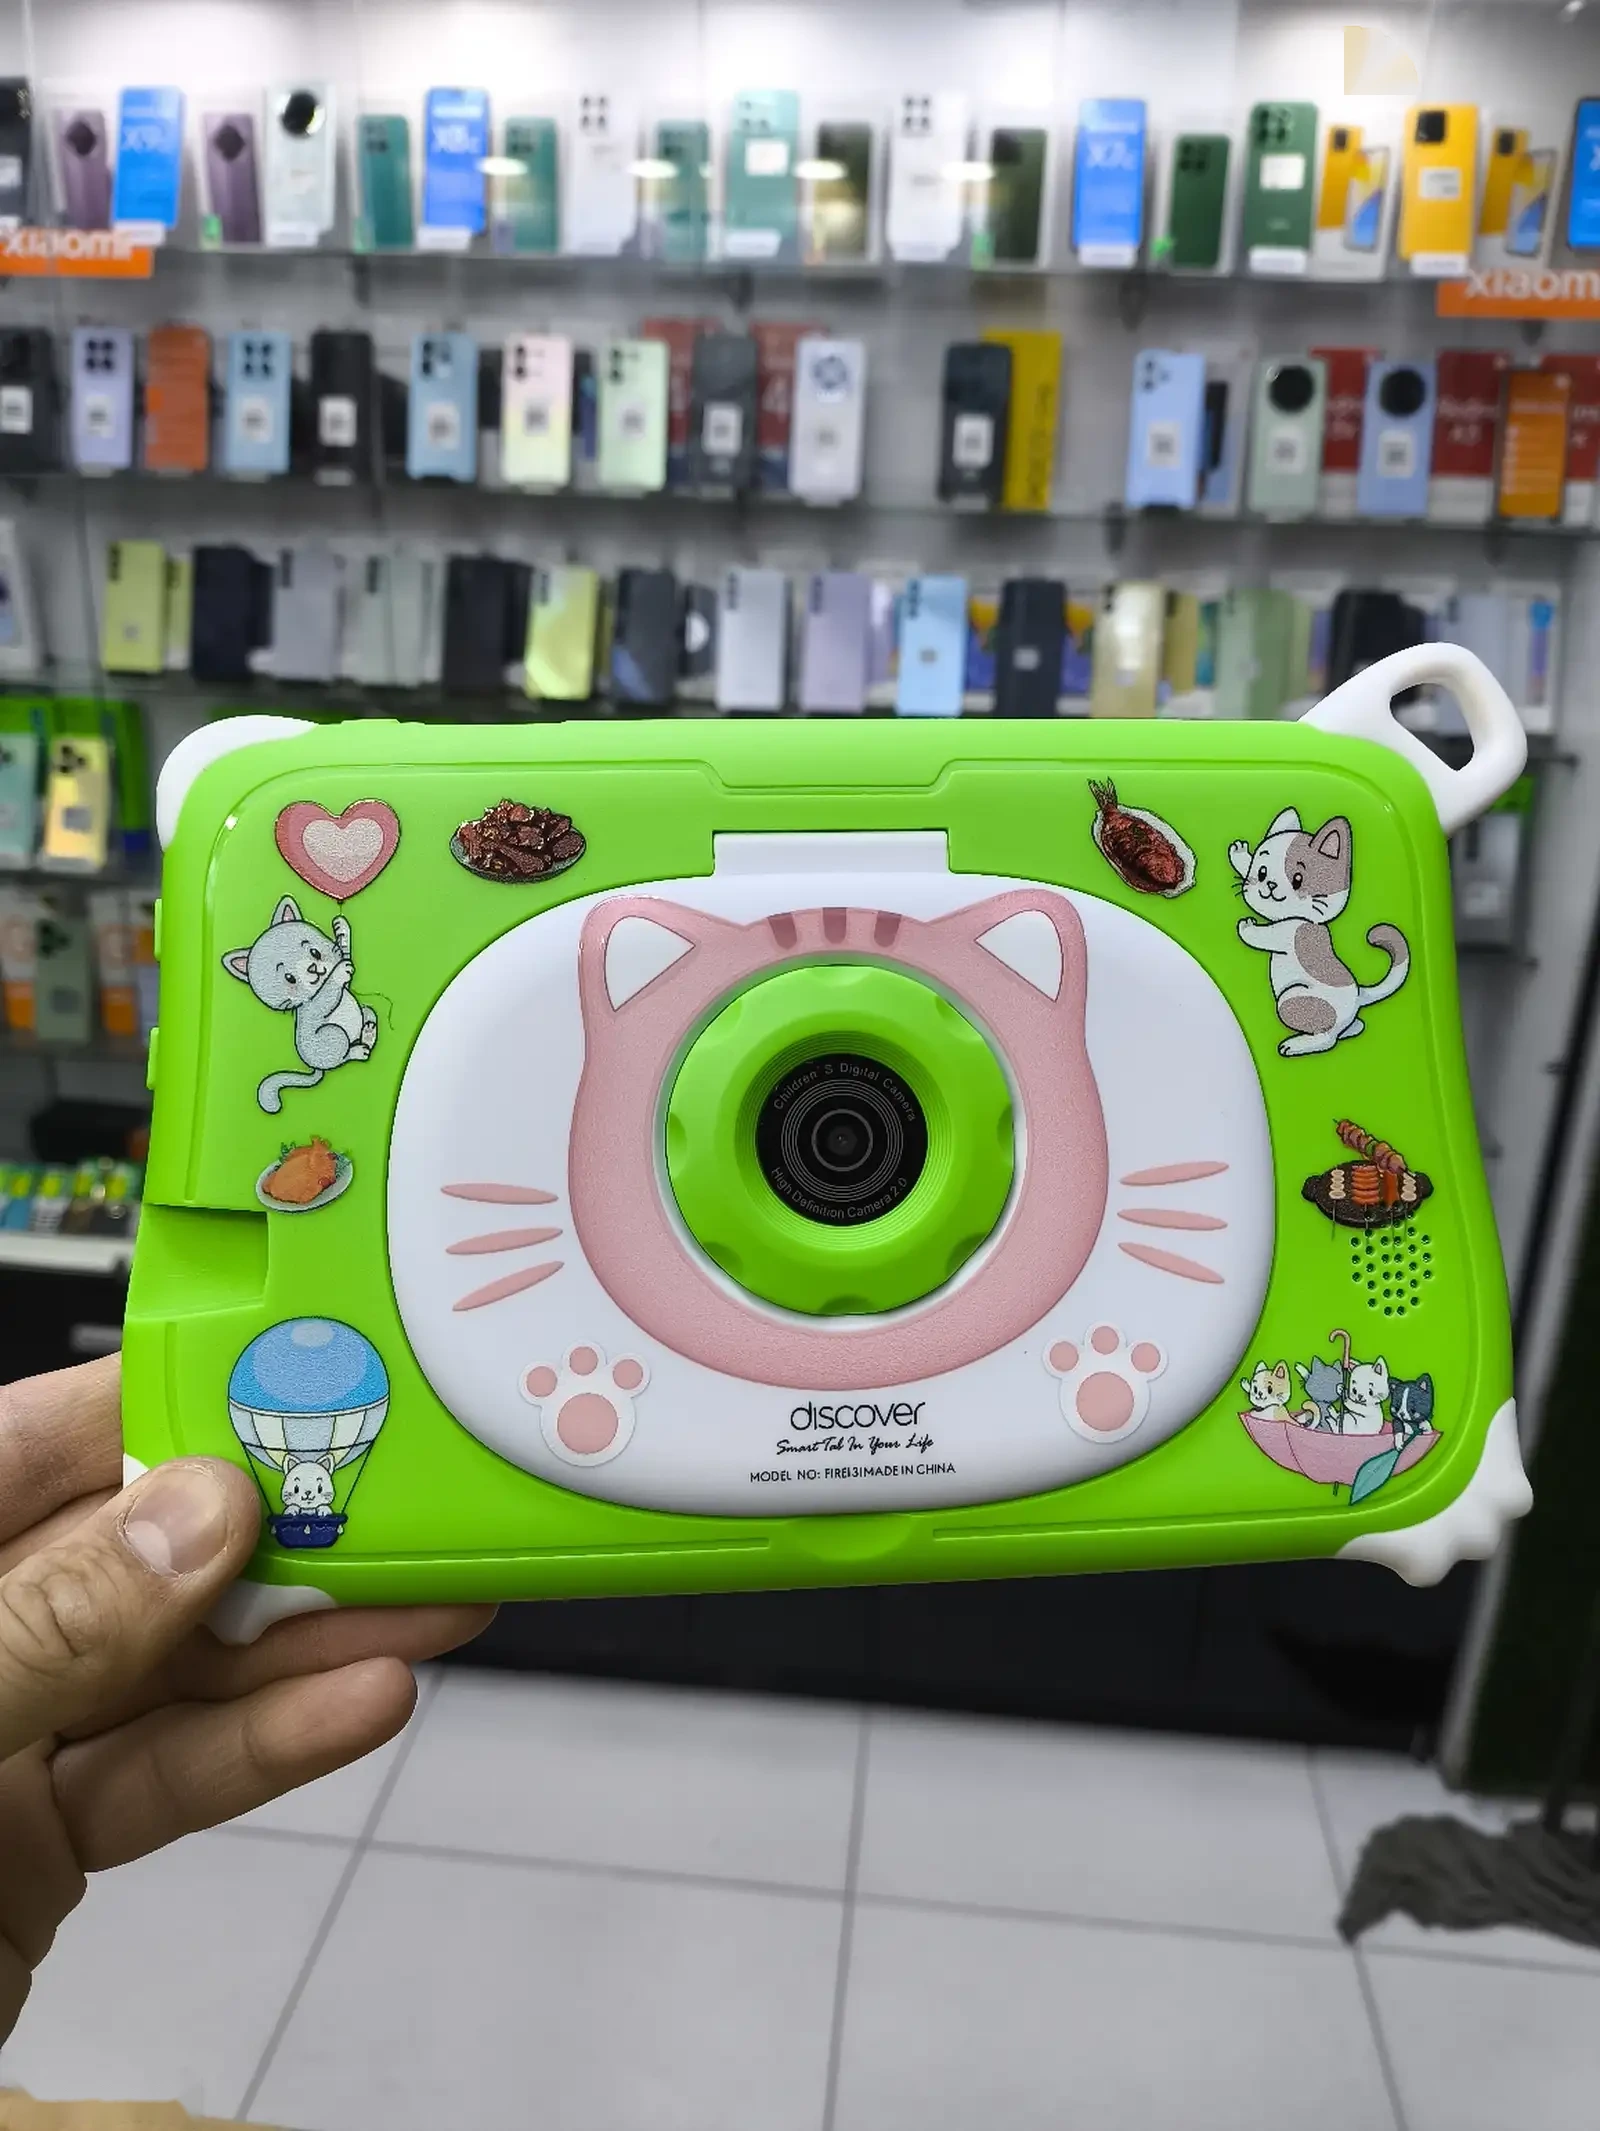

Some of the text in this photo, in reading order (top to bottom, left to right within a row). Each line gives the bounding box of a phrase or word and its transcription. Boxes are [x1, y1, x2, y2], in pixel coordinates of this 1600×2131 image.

[840, 1062, 880, 1081] Digital
[882, 1078, 916, 1121] Camera
[771, 1166, 792, 1195] High
[791, 1190, 845, 1219] Definition
[790, 1400, 926, 1431] discover
[776, 1438, 823, 1456] Smart
[847, 1436, 864, 1451] In
[868, 1435, 901, 1456] Your
[905, 1432, 934, 1454] Life
[750, 1470, 792, 1483] MODEL
[797, 1469, 821, 1481] NO:
[901, 1464, 914, 1475] IN
[916, 1462, 957, 1475] CHINA
